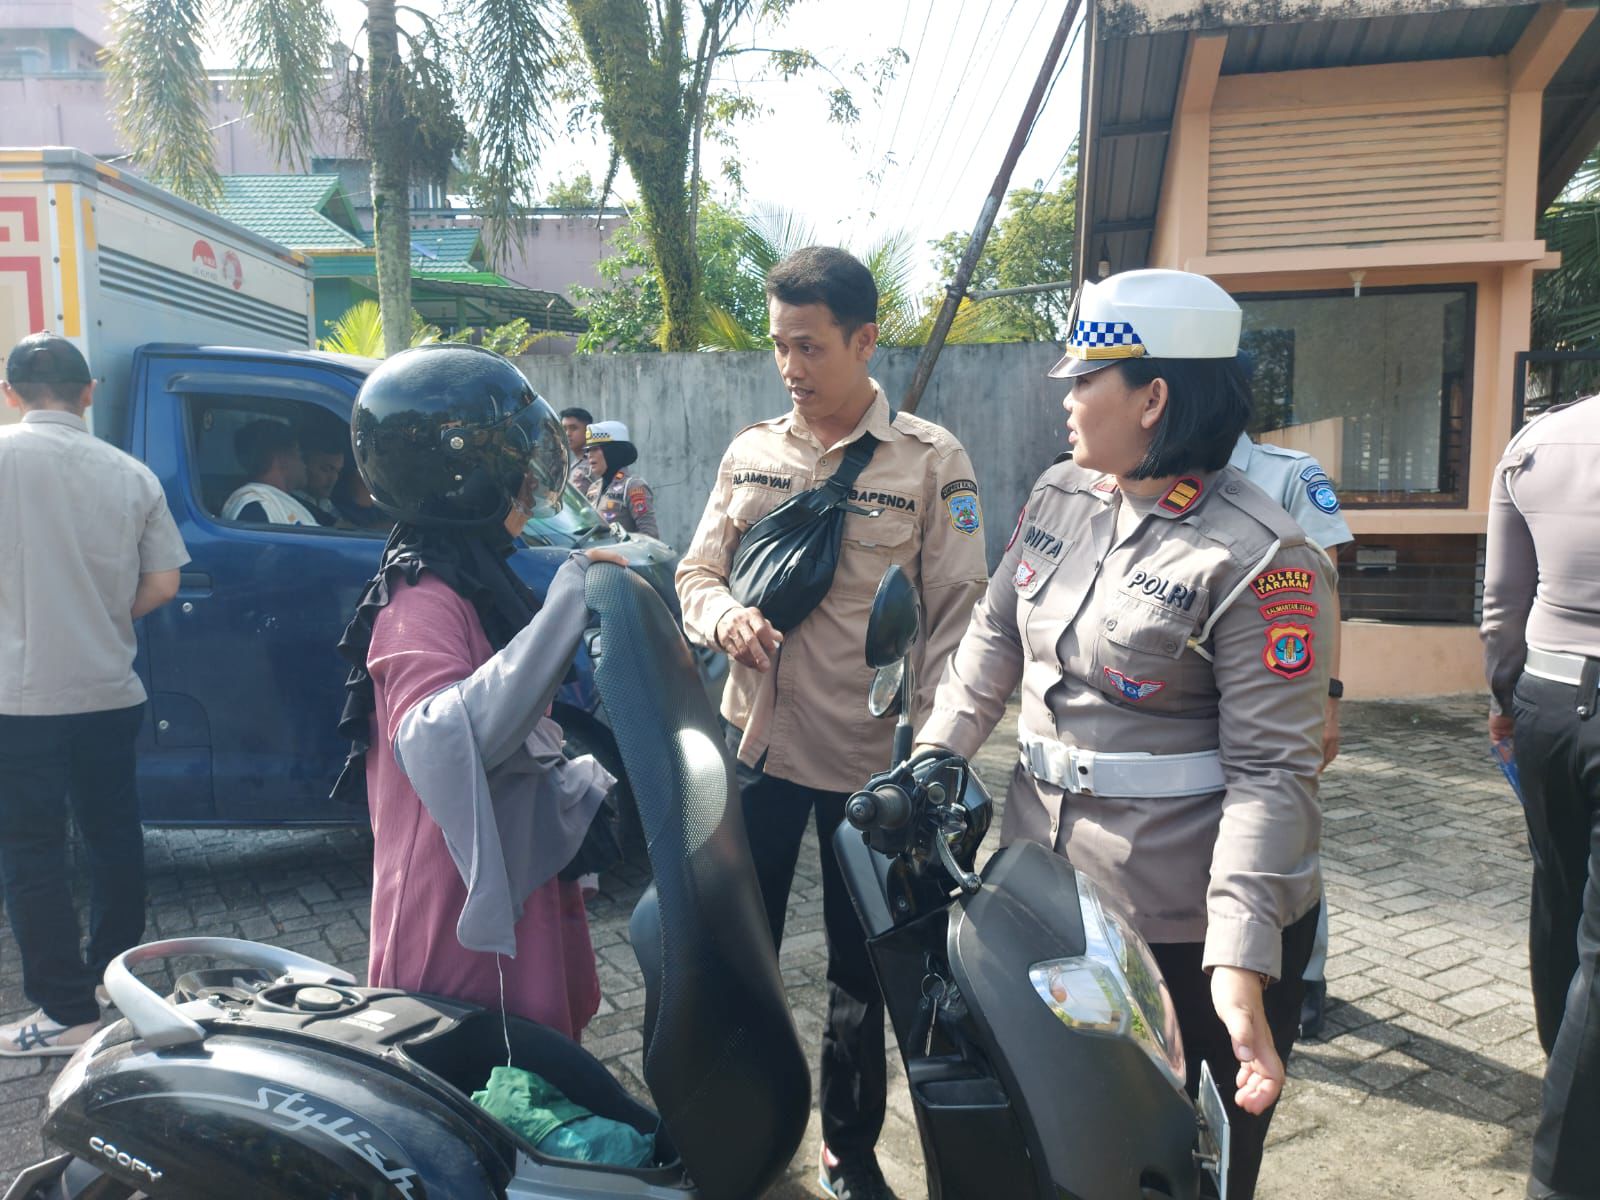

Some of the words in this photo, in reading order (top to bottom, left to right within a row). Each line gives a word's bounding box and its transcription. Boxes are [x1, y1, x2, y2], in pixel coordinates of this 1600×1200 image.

[733, 472, 791, 489] ALAMSYAH
[849, 489, 915, 512] BAPENDA
[1258, 571, 1308, 586] POLRES
[1258, 579, 1309, 594] TARAKAN
[1128, 571, 1197, 611] POLRI
